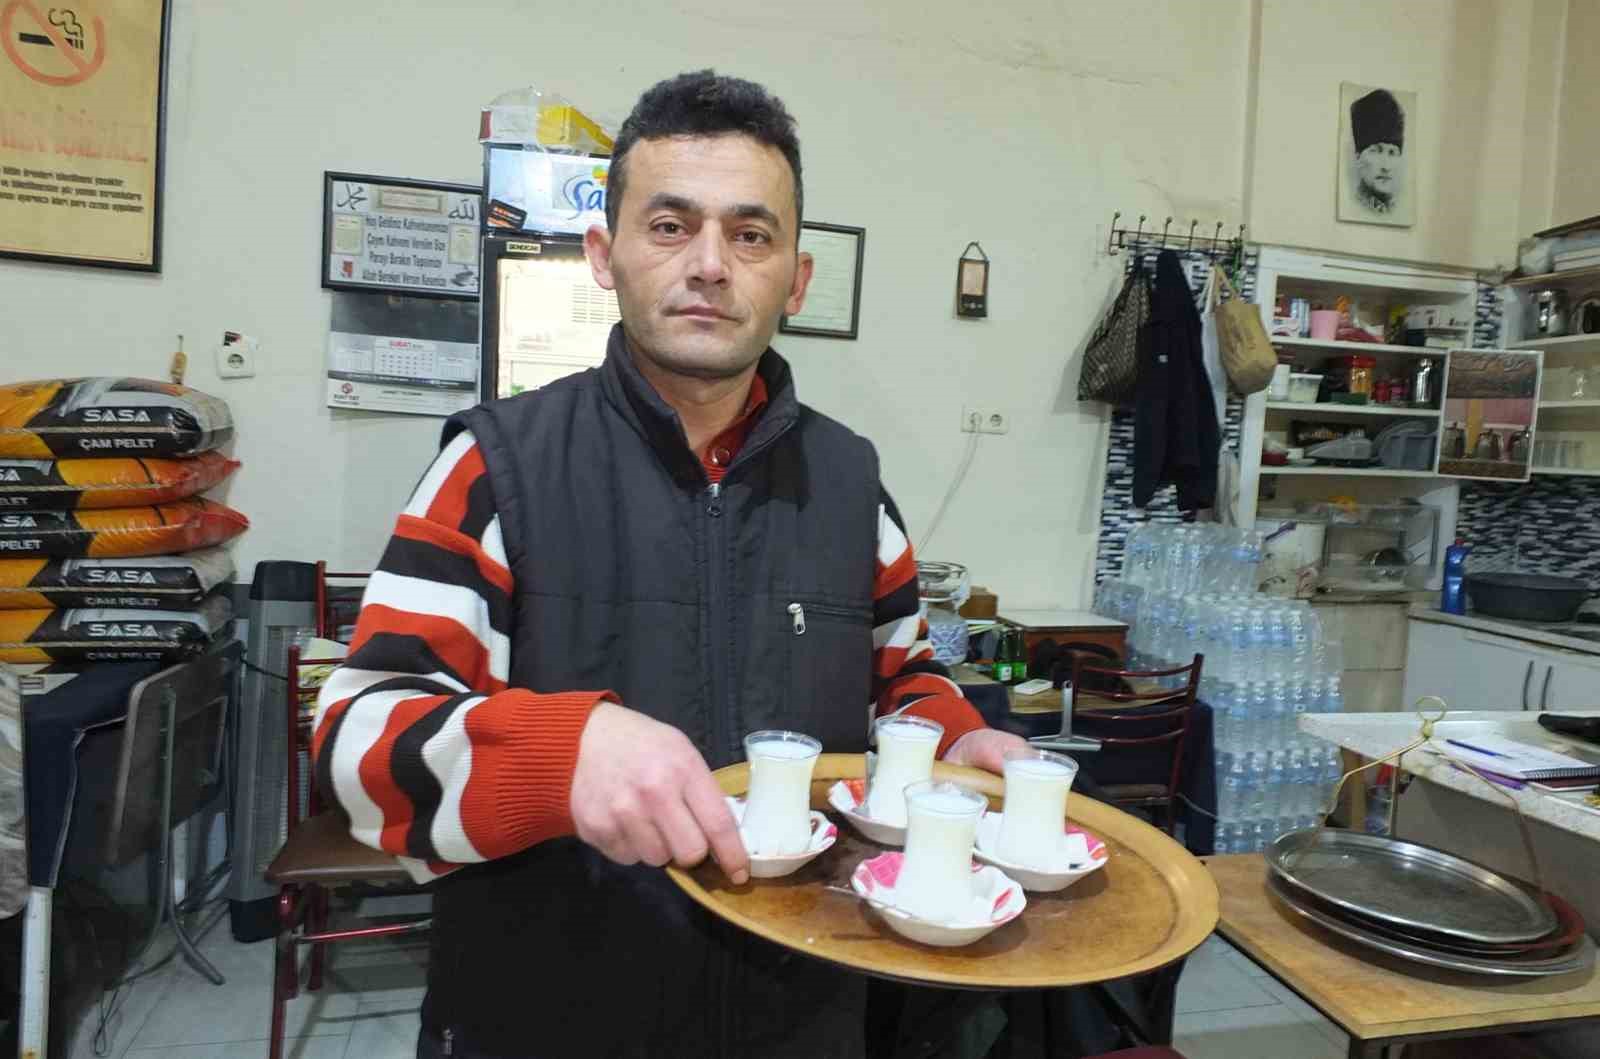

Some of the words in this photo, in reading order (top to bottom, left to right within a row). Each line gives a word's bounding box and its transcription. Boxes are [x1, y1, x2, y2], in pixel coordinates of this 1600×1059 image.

[84, 409, 151, 422] SASA
[80, 439, 112, 451] ÇAM
[114, 439, 156, 449] PELET
[87, 569, 156, 584] SASA
[87, 624, 158, 637] SASA
